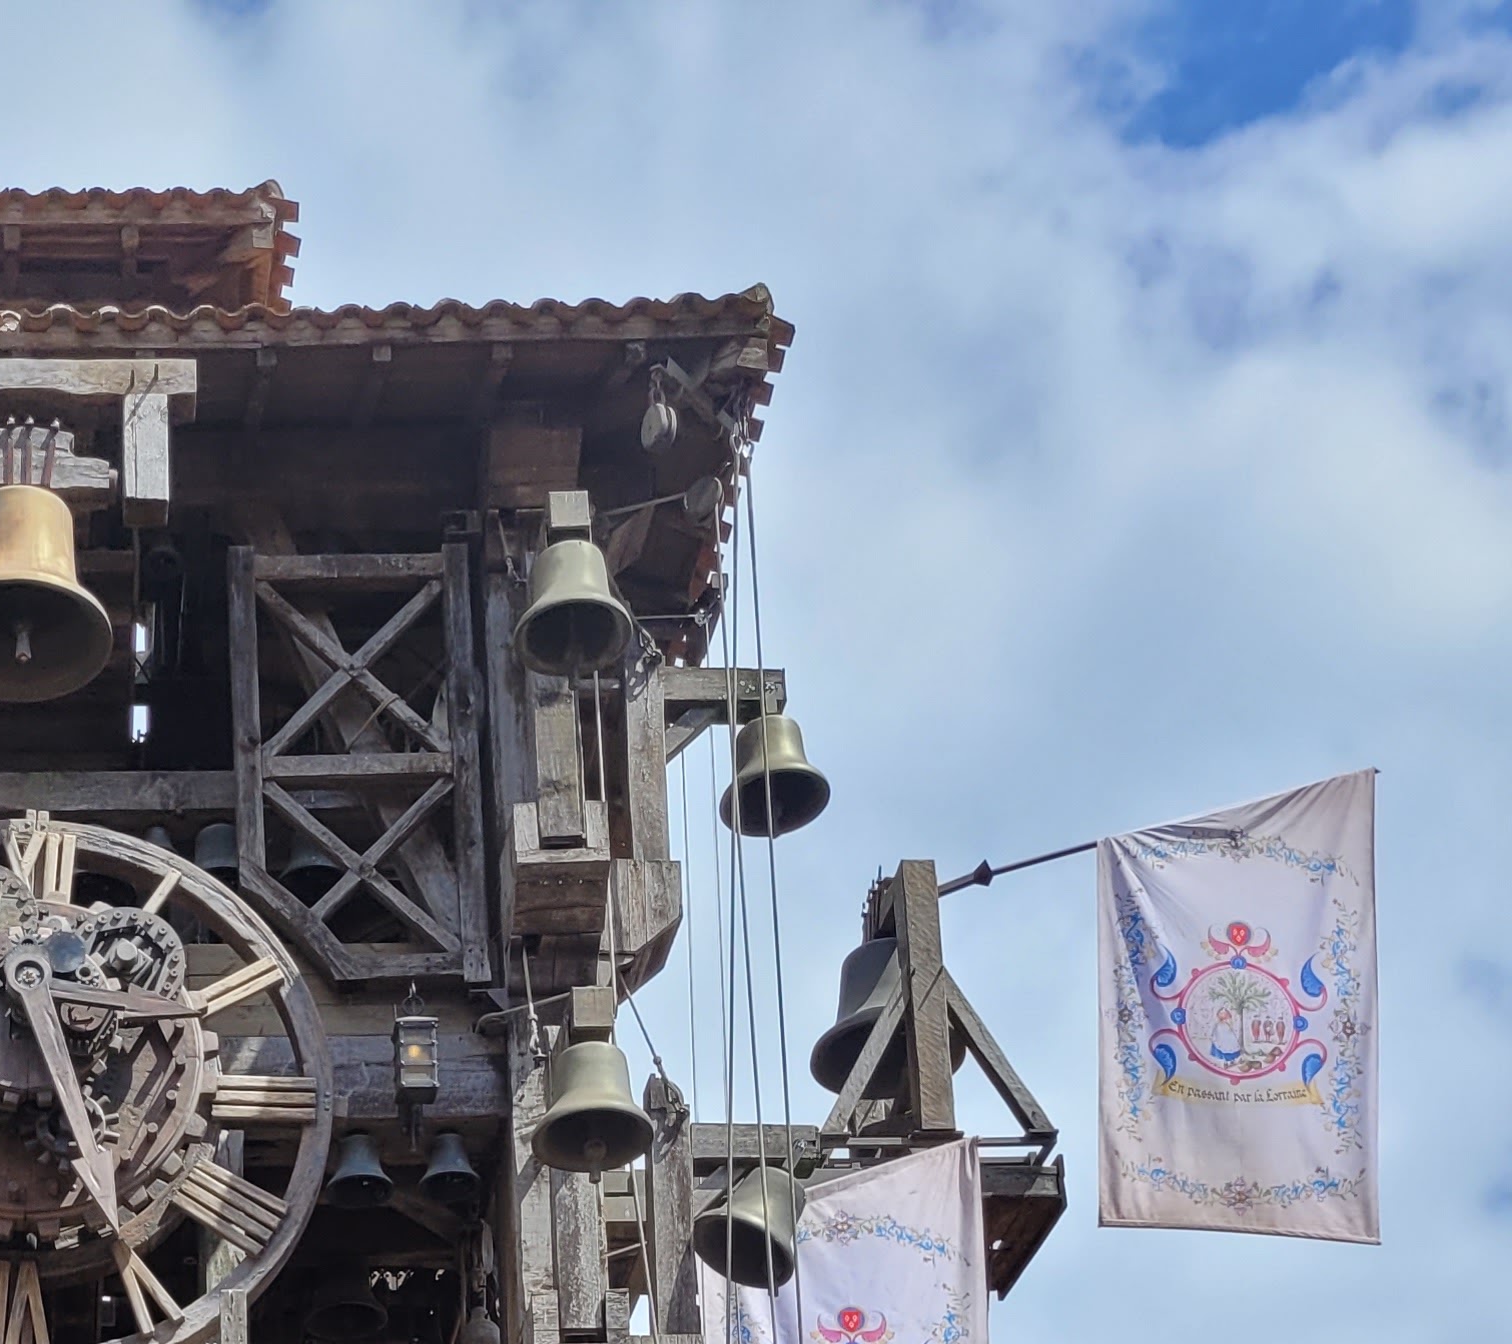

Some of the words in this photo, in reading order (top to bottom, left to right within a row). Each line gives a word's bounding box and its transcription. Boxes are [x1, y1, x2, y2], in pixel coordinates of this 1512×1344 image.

[211, 1075, 317, 1120] III
[1168, 1080, 1185, 1094] En
[1188, 1087, 1230, 1101] passant
[1234, 1092, 1252, 1103] par
[1254, 1089, 1264, 1102] la
[1266, 1088, 1308, 1102] Lorraine
